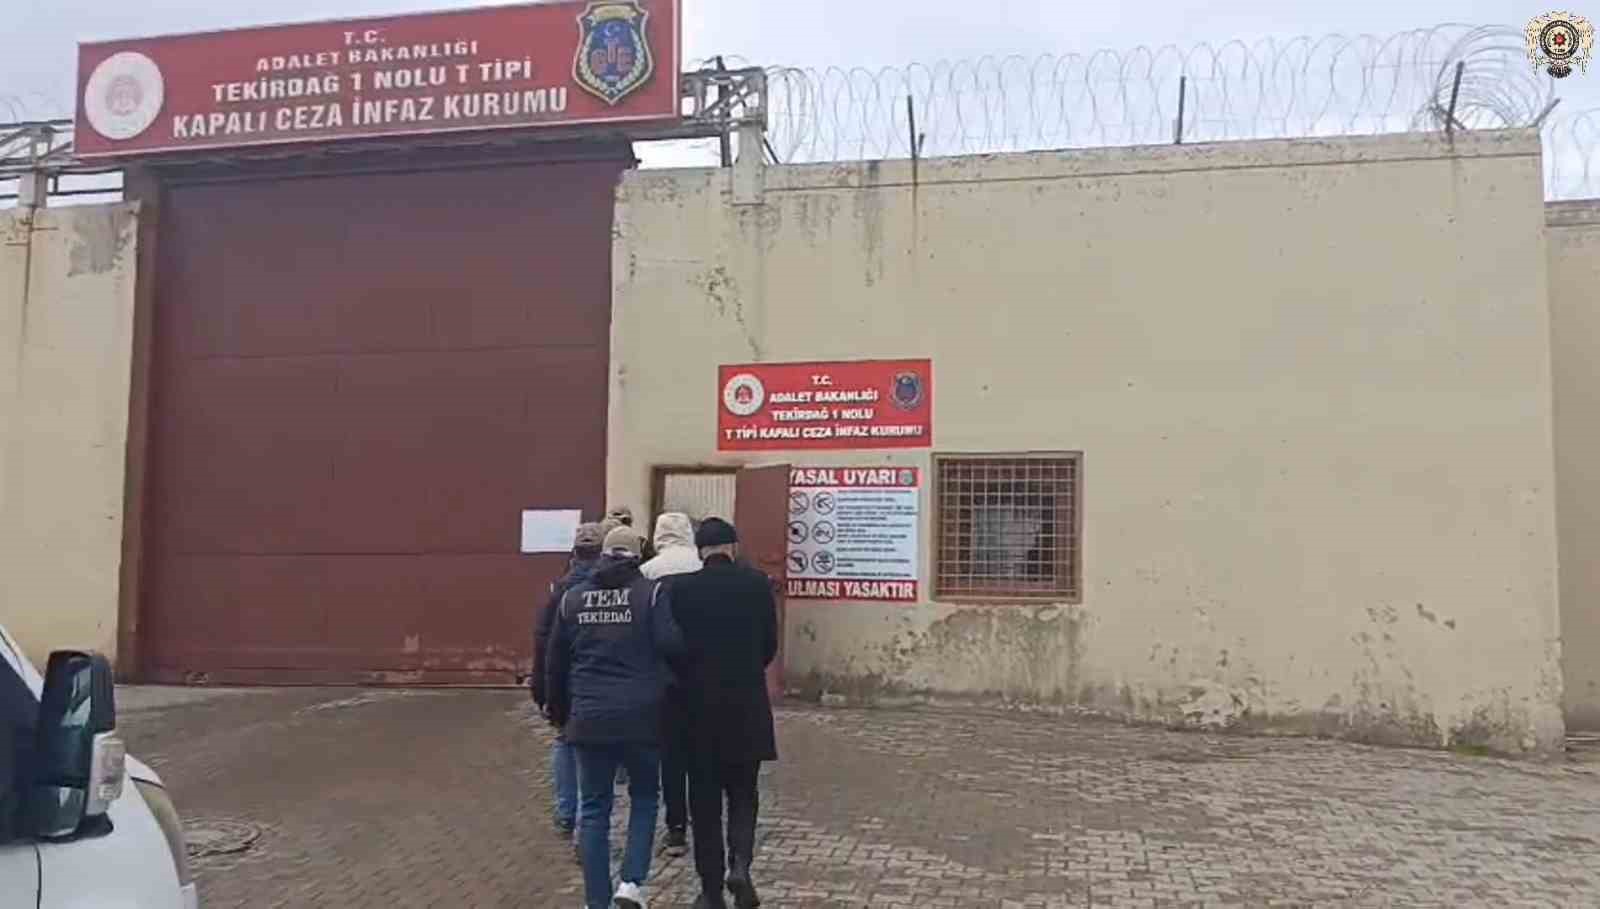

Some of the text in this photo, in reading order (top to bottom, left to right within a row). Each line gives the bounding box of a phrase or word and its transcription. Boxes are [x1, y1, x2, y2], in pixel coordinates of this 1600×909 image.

[344, 30, 386, 45] T.C.
[256, 39, 478, 72] ADALET BAKANLIĞI
[211, 56, 532, 102] TEKİRDAĞ 1 NOLU T TİPİ
[173, 87, 568, 138] KAPALI CEZA İNFAZ KURUMU
[811, 375, 833, 385] T.C.
[769, 389, 878, 403] ADALET BAKANLIĞI
[771, 407, 874, 421] TEKİRDAĞ 1 NOLU
[725, 423, 922, 439] T TİPİ KAPALI CEZA İNFAZ KURUMU
[844, 468, 897, 485] UYARI
[582, 588, 631, 607] TEM
[843, 581, 914, 598] YASAKTIR
[576, 609, 632, 624] TEKİRDAĞ
